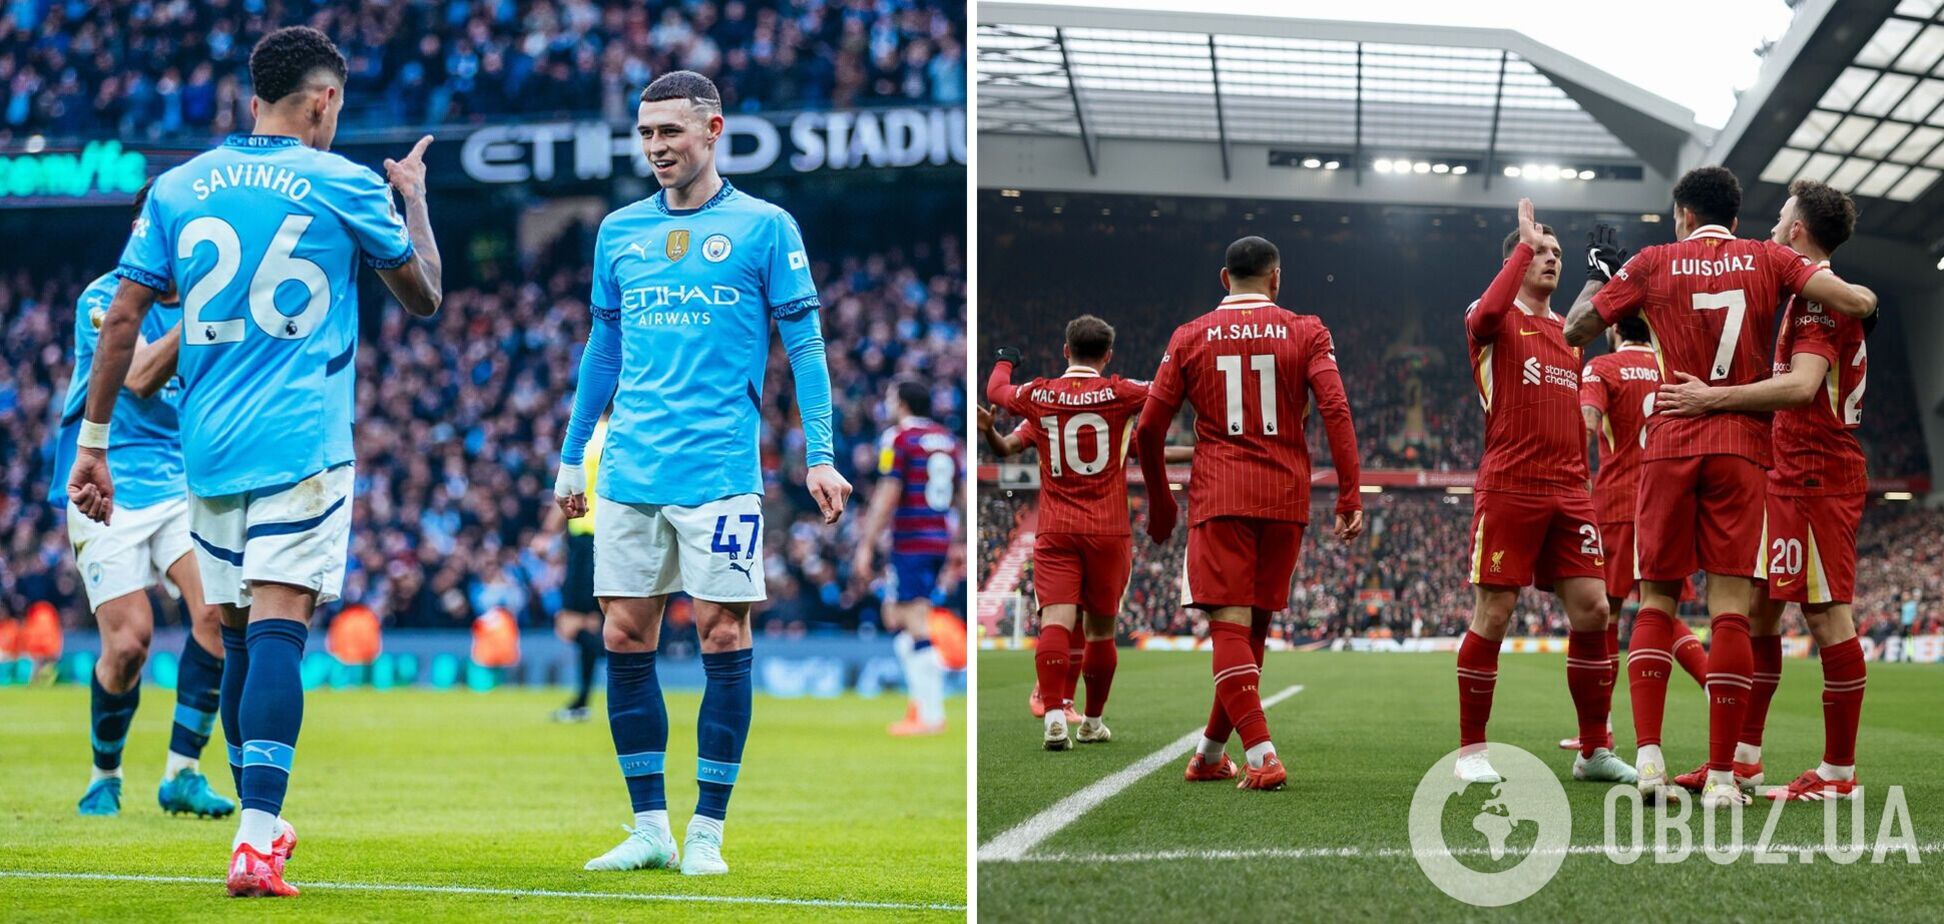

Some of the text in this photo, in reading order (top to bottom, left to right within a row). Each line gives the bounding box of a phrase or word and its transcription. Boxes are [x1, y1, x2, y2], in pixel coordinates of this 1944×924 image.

[461, 114, 782, 183] ETIHD
[192, 164, 312, 201] SAVINHO
[177, 214, 331, 346] 26
[623, 285, 740, 309] ETIHAD
[639, 312, 711, 327] AIRWAYS
[1207, 323, 1287, 342] M.SALAH
[1692, 288, 1747, 381] 7
[1619, 367, 1660, 383] SZOBO
[1844, 340, 1868, 425] 2
[1031, 387, 1117, 406] MAC ALLISTER
[1216, 354, 1279, 437] 11
[1040, 412, 1110, 478] 10
[925, 451, 956, 513] 8
[711, 514, 760, 560] 47
[1578, 524, 1600, 555] 2
[1769, 538, 1803, 575] 20
[1641, 670, 1662, 678] LFC
[1716, 697, 1736, 705] LFC
[702, 767, 727, 776] CITY
